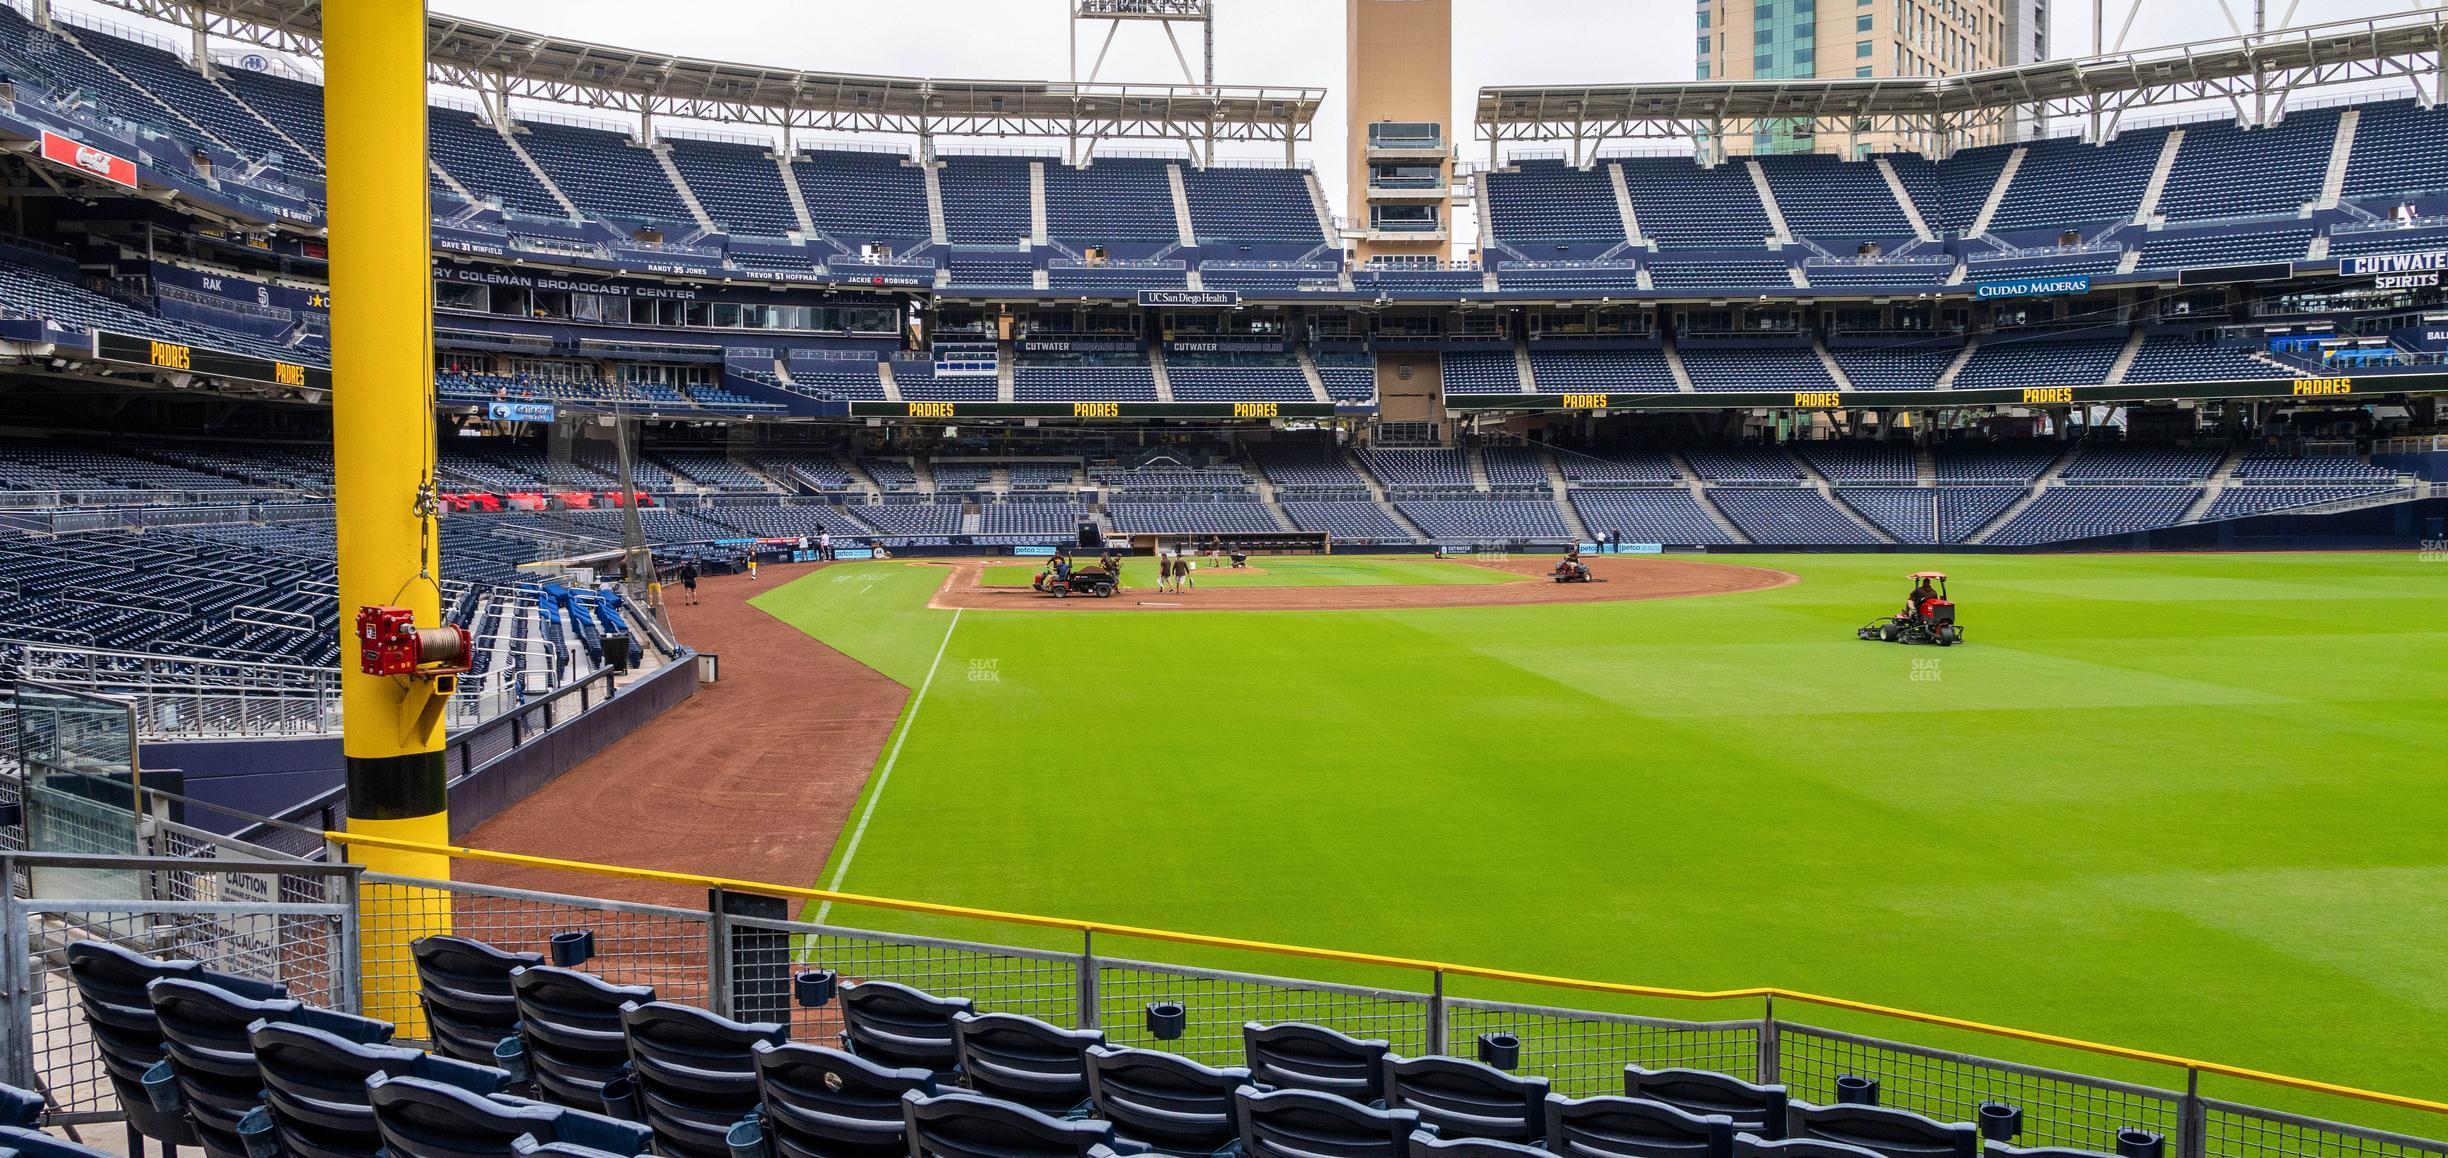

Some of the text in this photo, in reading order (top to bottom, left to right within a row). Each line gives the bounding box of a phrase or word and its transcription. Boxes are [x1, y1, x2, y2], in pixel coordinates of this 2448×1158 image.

[441, 241, 503, 255] DAVE 31 WINFIELD
[673, 266, 684, 274] 35
[685, 267, 707, 275] JONES
[775, 272, 784, 280] 51
[203, 278, 222, 291] RAK
[459, 270, 532, 287] COLEMAN
[537, 278, 630, 295] BROADCAST
[636, 287, 695, 299] CENTER
[872, 276, 884, 284] 42
[2375, 274, 2439, 289] SPIRITS
[1979, 280, 2086, 297] CIUDAD MADERAS
[1148, 292, 1228, 304] UC San Diego Health
[1025, 342, 1070, 351] CUTWATER
[1174, 342, 1217, 351] CUTWATER
[151, 340, 190, 369] PADRES
[275, 361, 305, 386] PADRES
[2293, 378, 2352, 395] PADRES
[1563, 394, 1607, 408] PADRES
[1795, 393, 1839, 407] PADRES
[2023, 388, 2073, 403] PADRES
[909, 403, 954, 417] PADRES
[1074, 402, 1119, 417] PADRES
[1234, 402, 1278, 417] PADRES
[1016, 546, 1035, 554] petco
[226, 872, 267, 895] CAUTION
